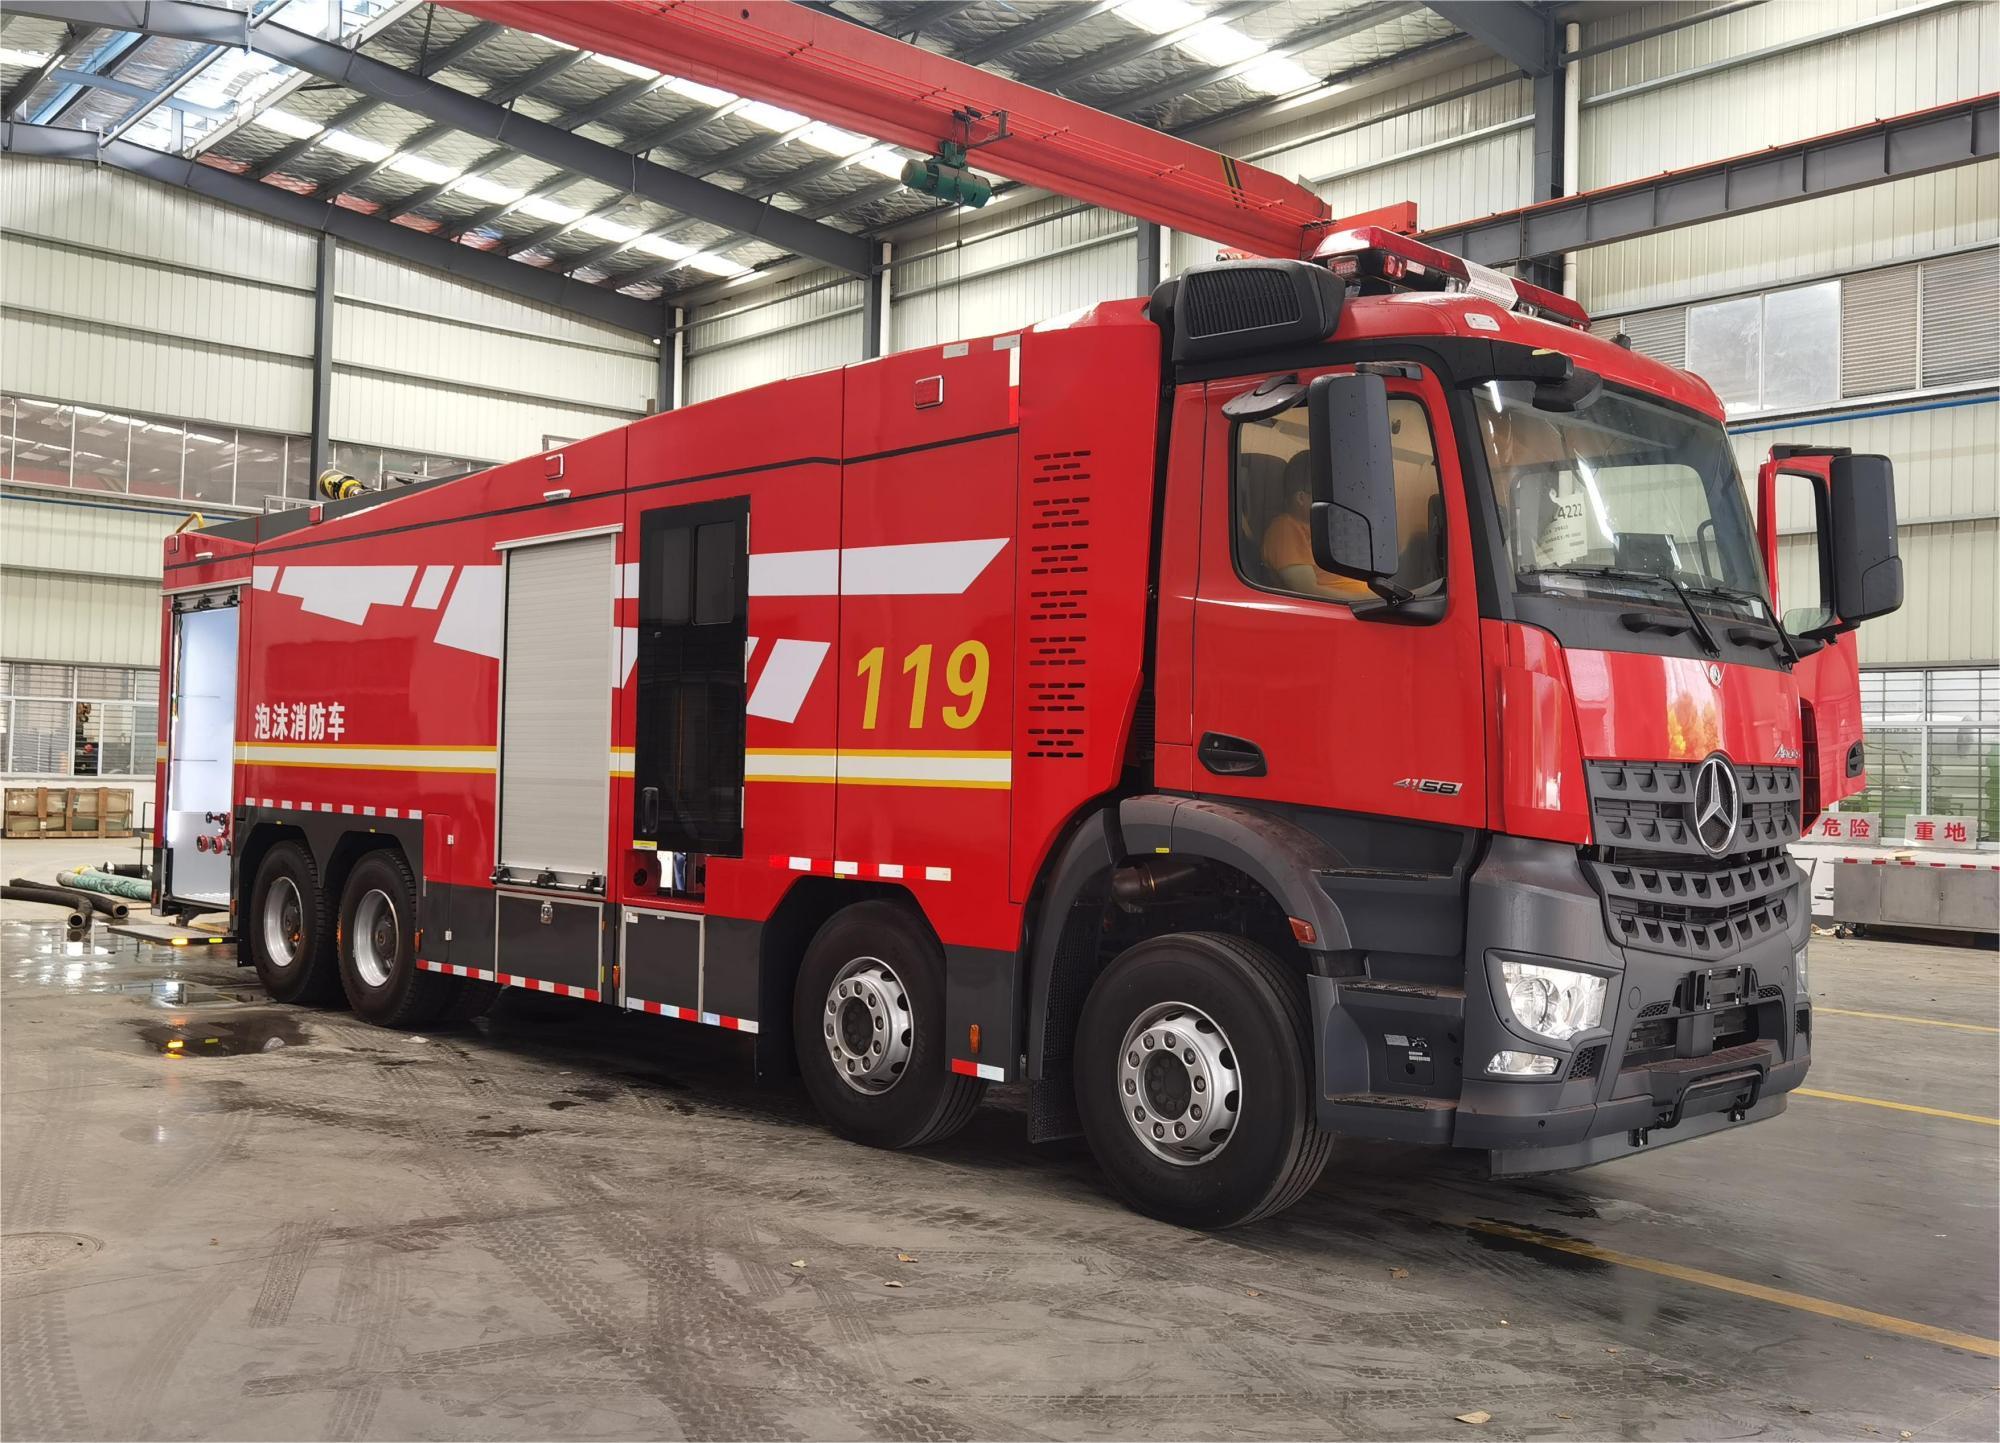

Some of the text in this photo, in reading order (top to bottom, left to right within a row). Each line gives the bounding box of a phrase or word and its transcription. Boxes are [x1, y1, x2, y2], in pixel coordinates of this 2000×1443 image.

[857, 639, 990, 730] 119
[254, 701, 345, 741] 泡沫消防车
[1393, 778, 1462, 796] 4158
[1822, 818, 1967, 842] 危险 重地
